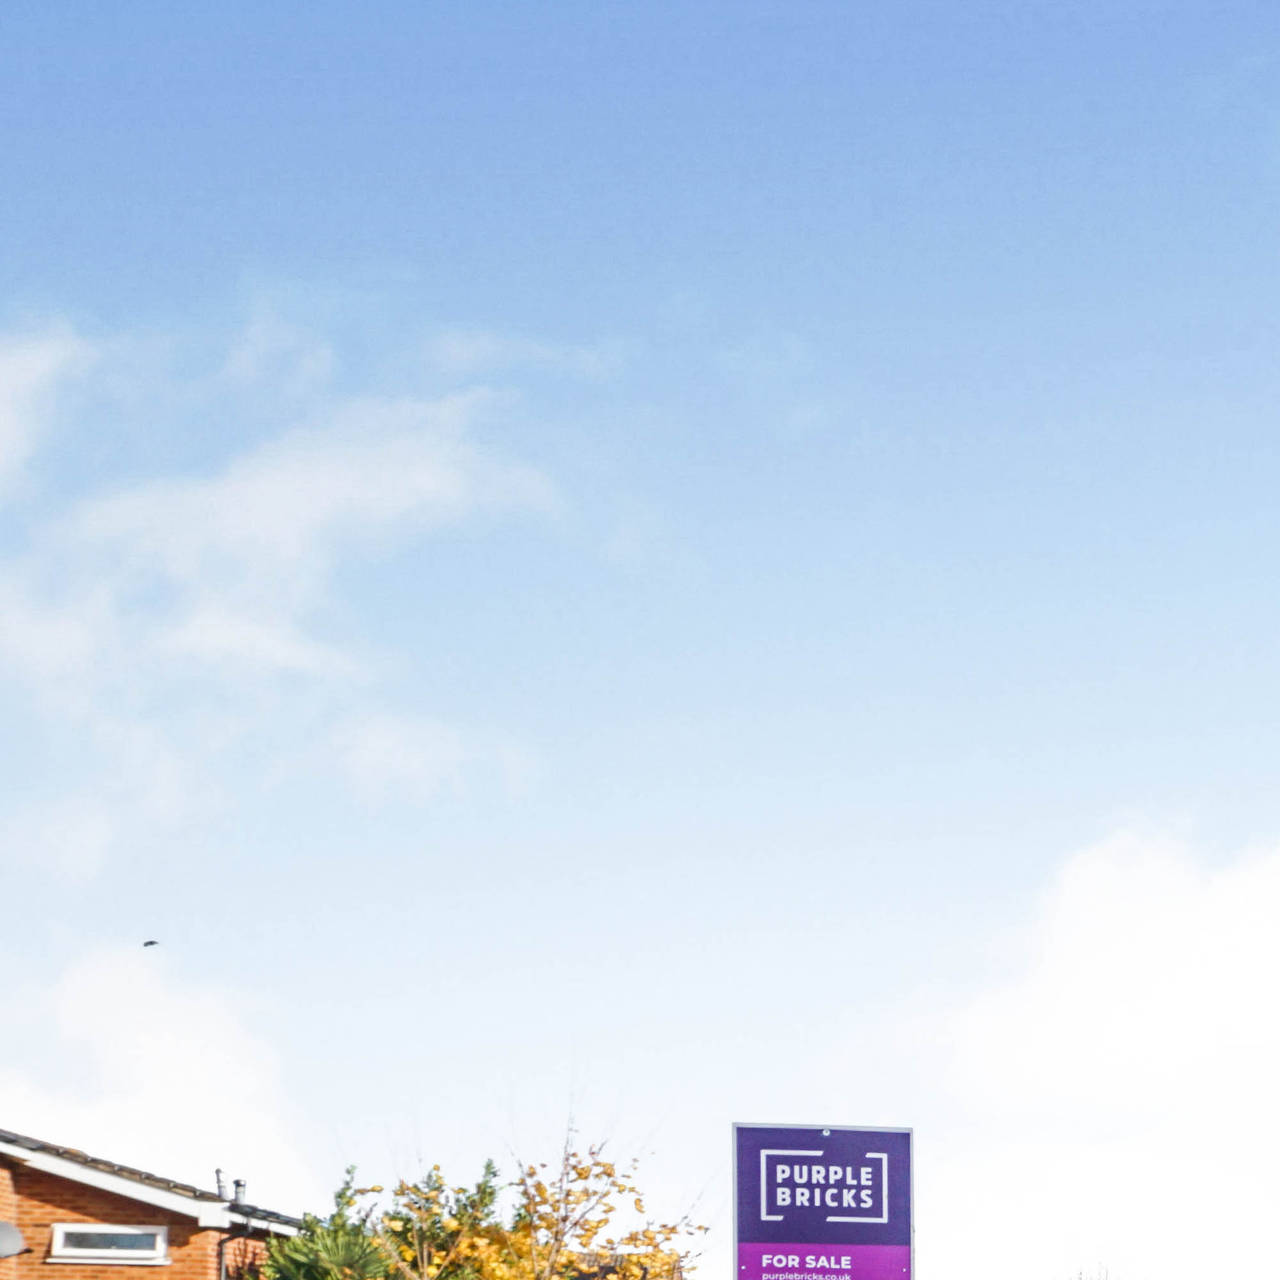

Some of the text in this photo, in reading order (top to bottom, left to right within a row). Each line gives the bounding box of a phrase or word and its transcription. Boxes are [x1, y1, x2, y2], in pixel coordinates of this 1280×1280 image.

[776, 1165, 873, 1186] PURPLE
[776, 1187, 873, 1208] BRICKS
[762, 1254, 852, 1269] FOR SALE
